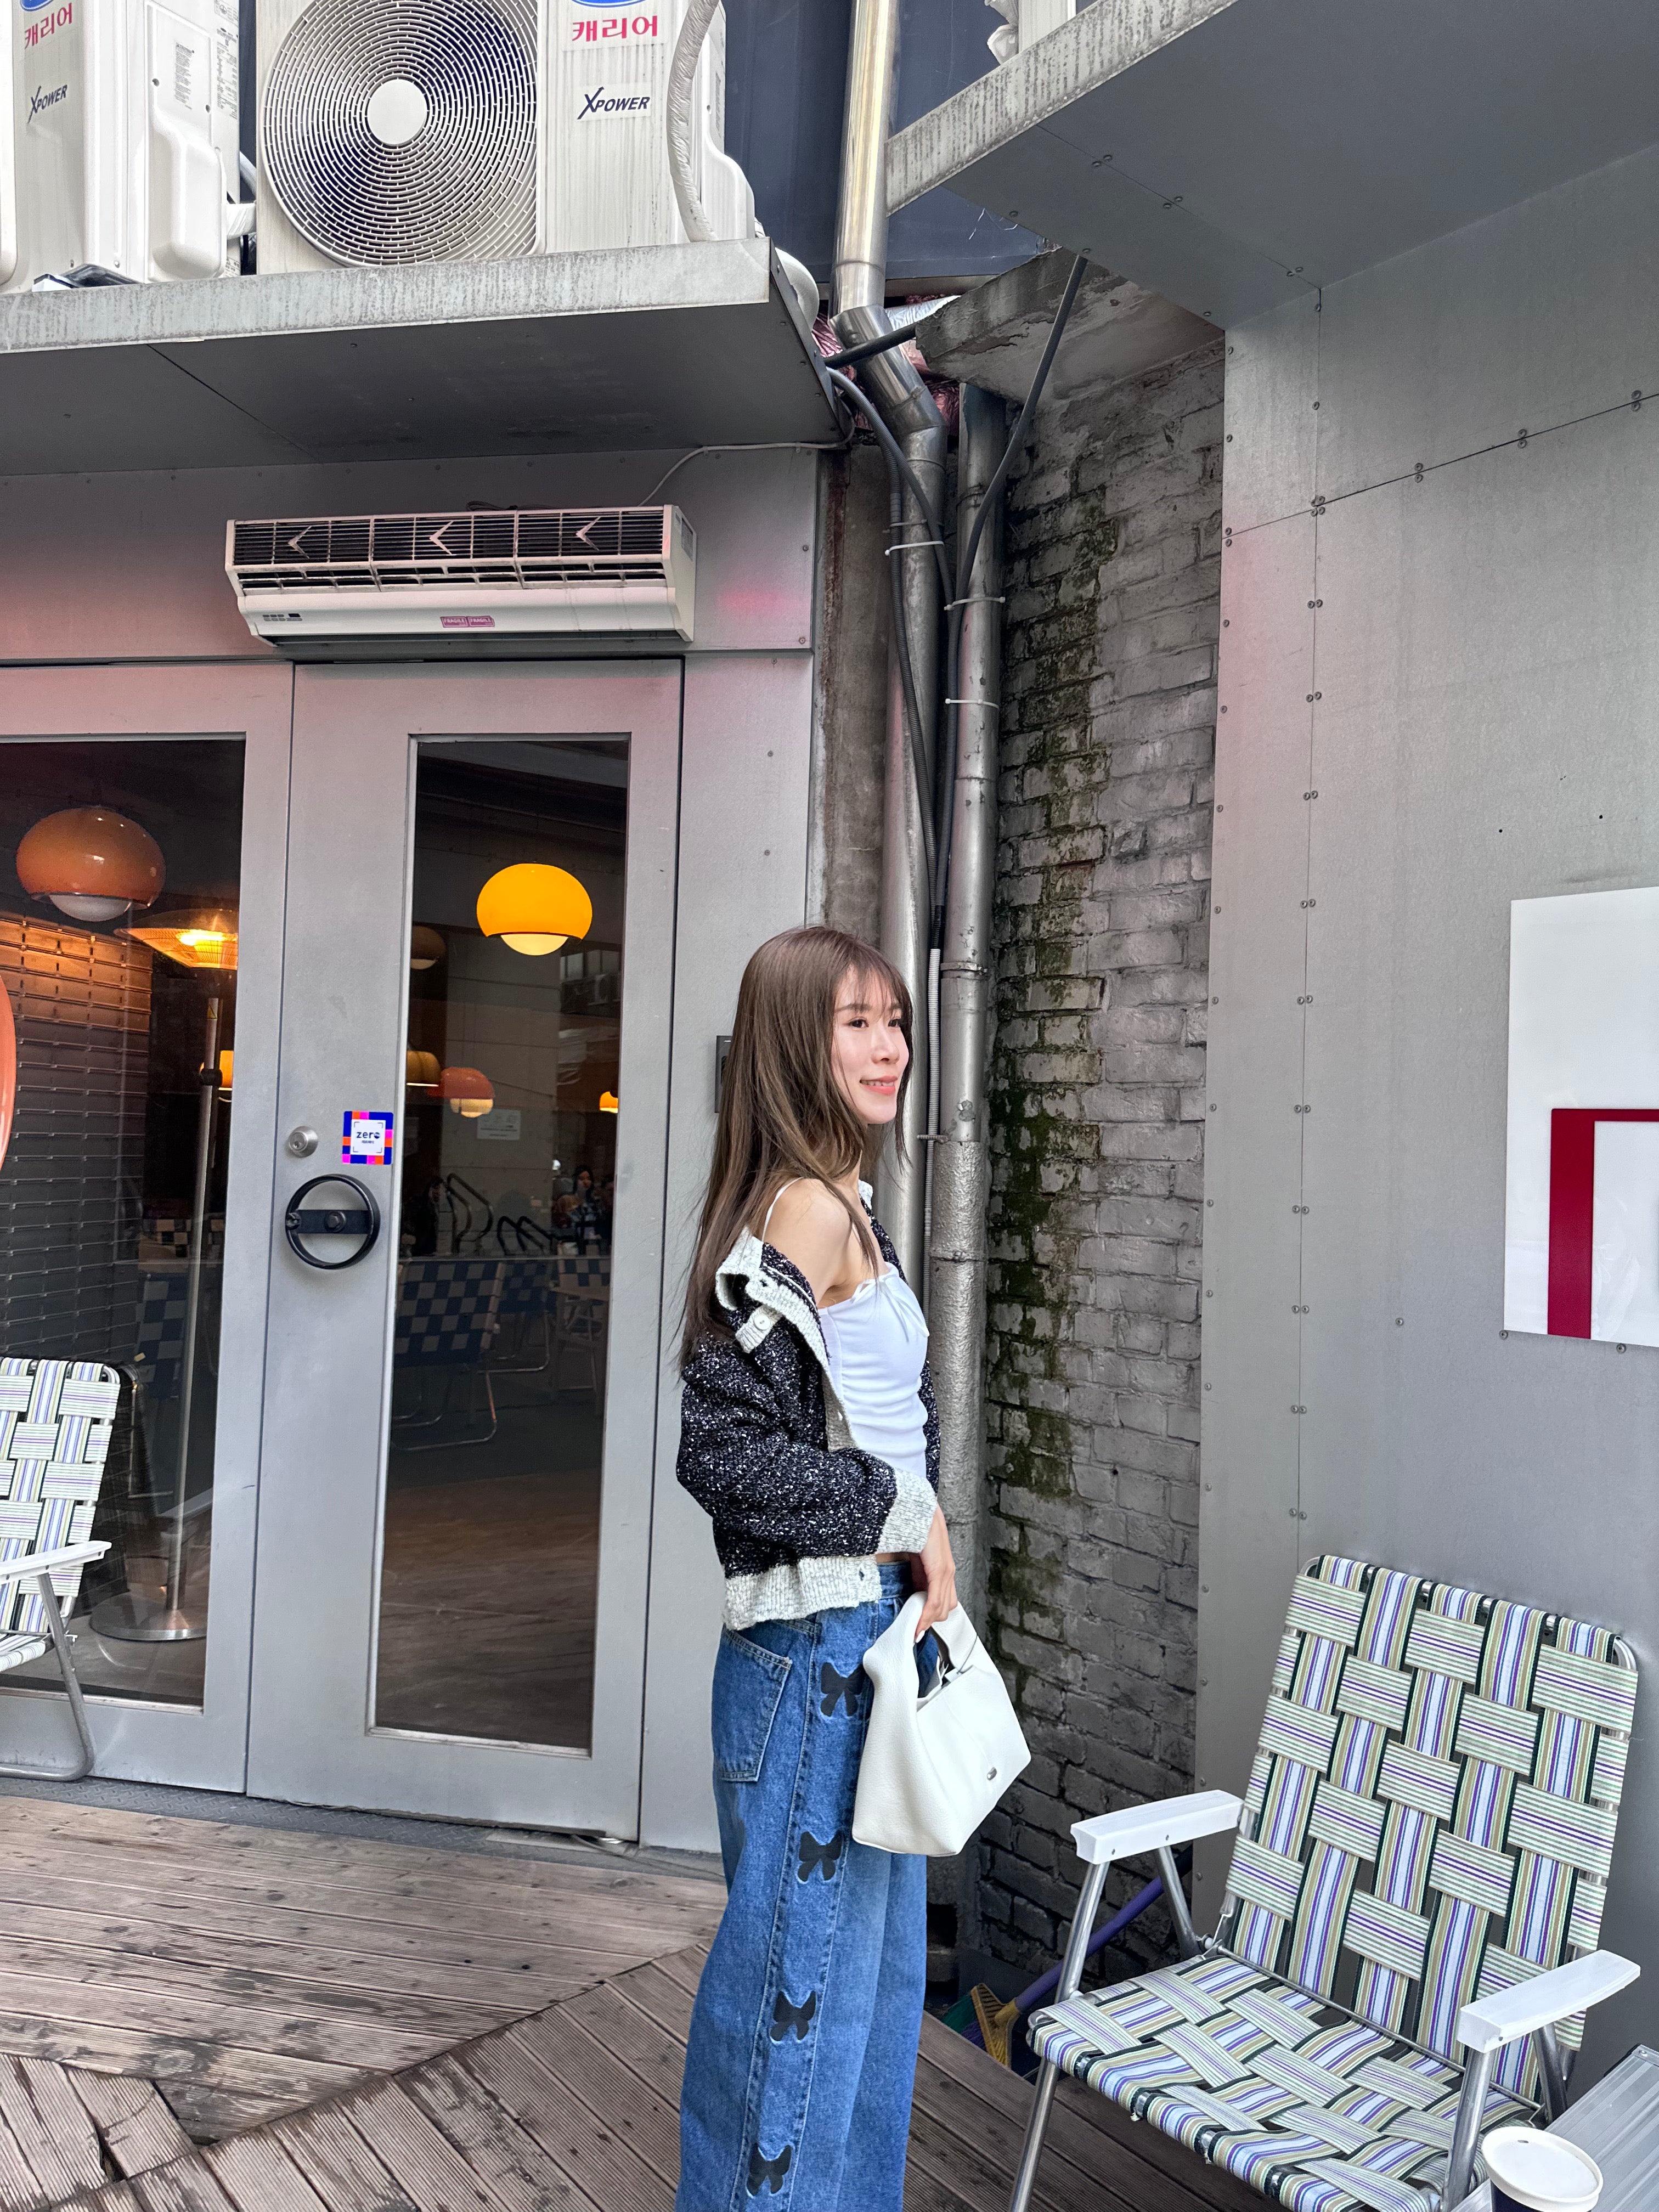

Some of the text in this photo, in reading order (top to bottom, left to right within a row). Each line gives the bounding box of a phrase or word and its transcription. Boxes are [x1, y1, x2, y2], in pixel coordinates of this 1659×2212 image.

[24, 3, 72, 49] 캐리어
[572, 15, 658, 42] 캐리어
[27, 84, 67, 123] XPOWER
[577, 86, 650, 120] XPOWER
